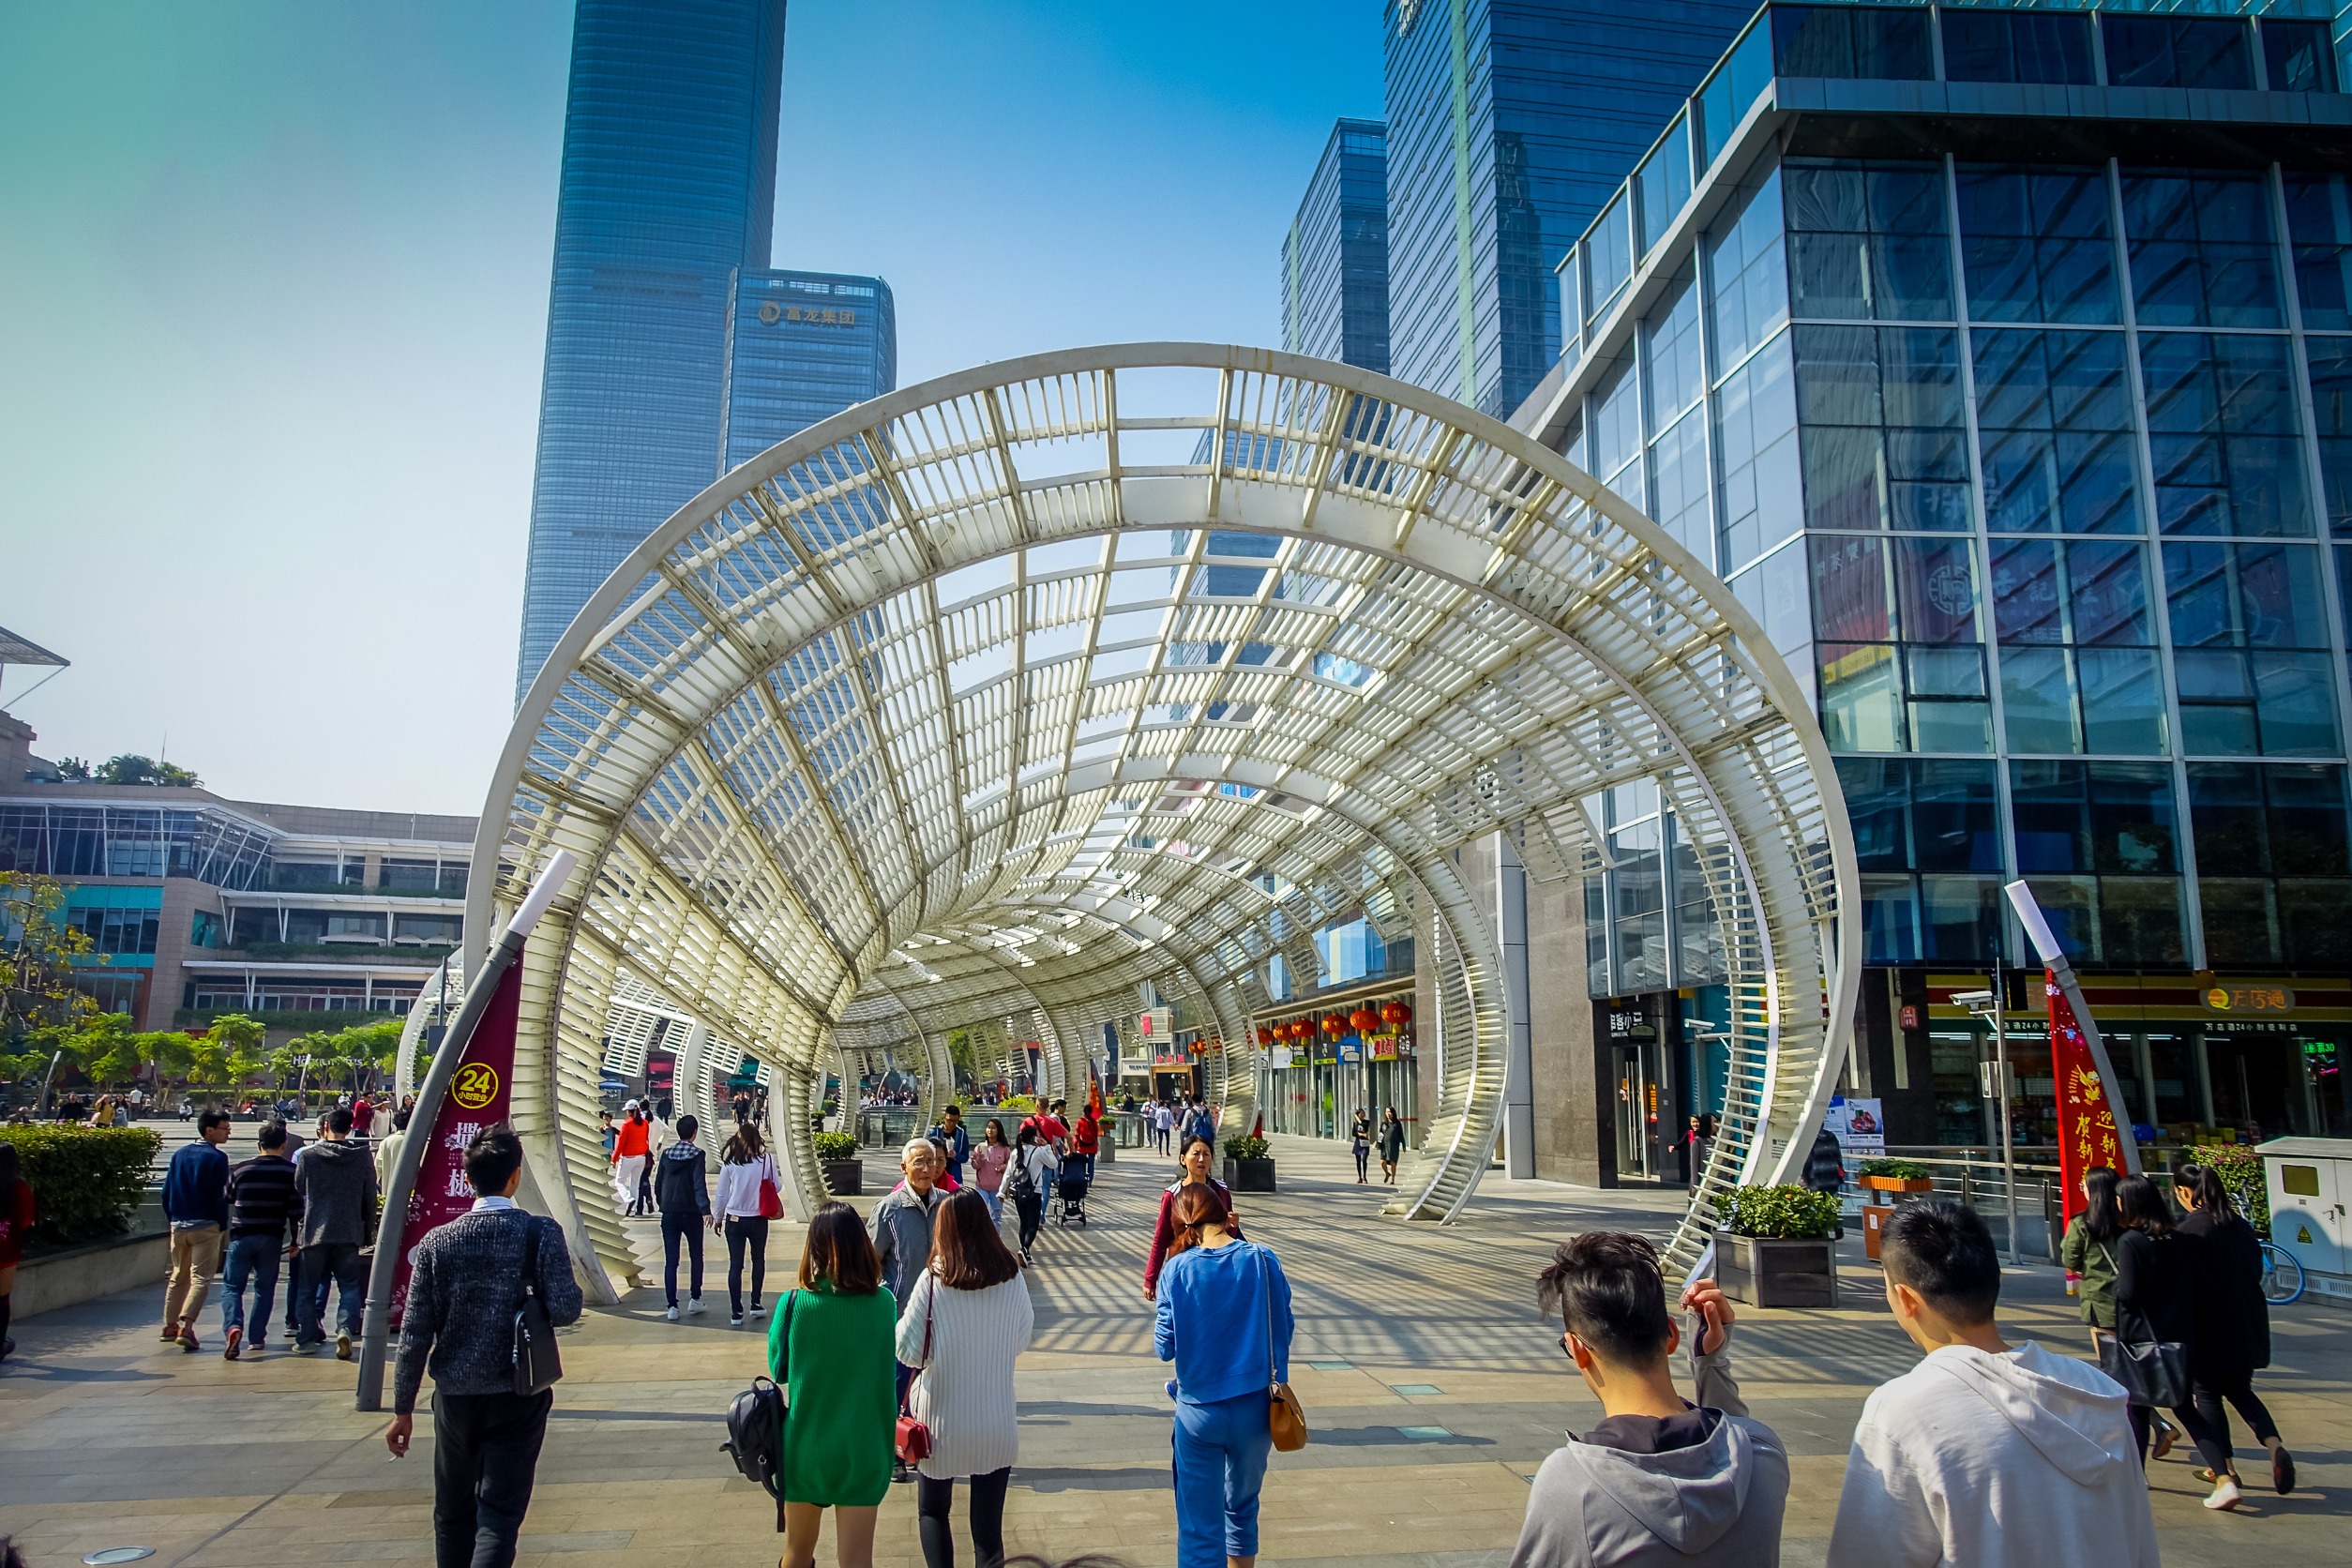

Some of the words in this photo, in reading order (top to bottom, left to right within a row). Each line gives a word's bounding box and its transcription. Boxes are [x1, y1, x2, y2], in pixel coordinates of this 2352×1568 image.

[2232, 986, 2287, 1010] 万店通
[460, 1070, 490, 1093] 24
[459, 1092, 488, 1102] 小时营业
